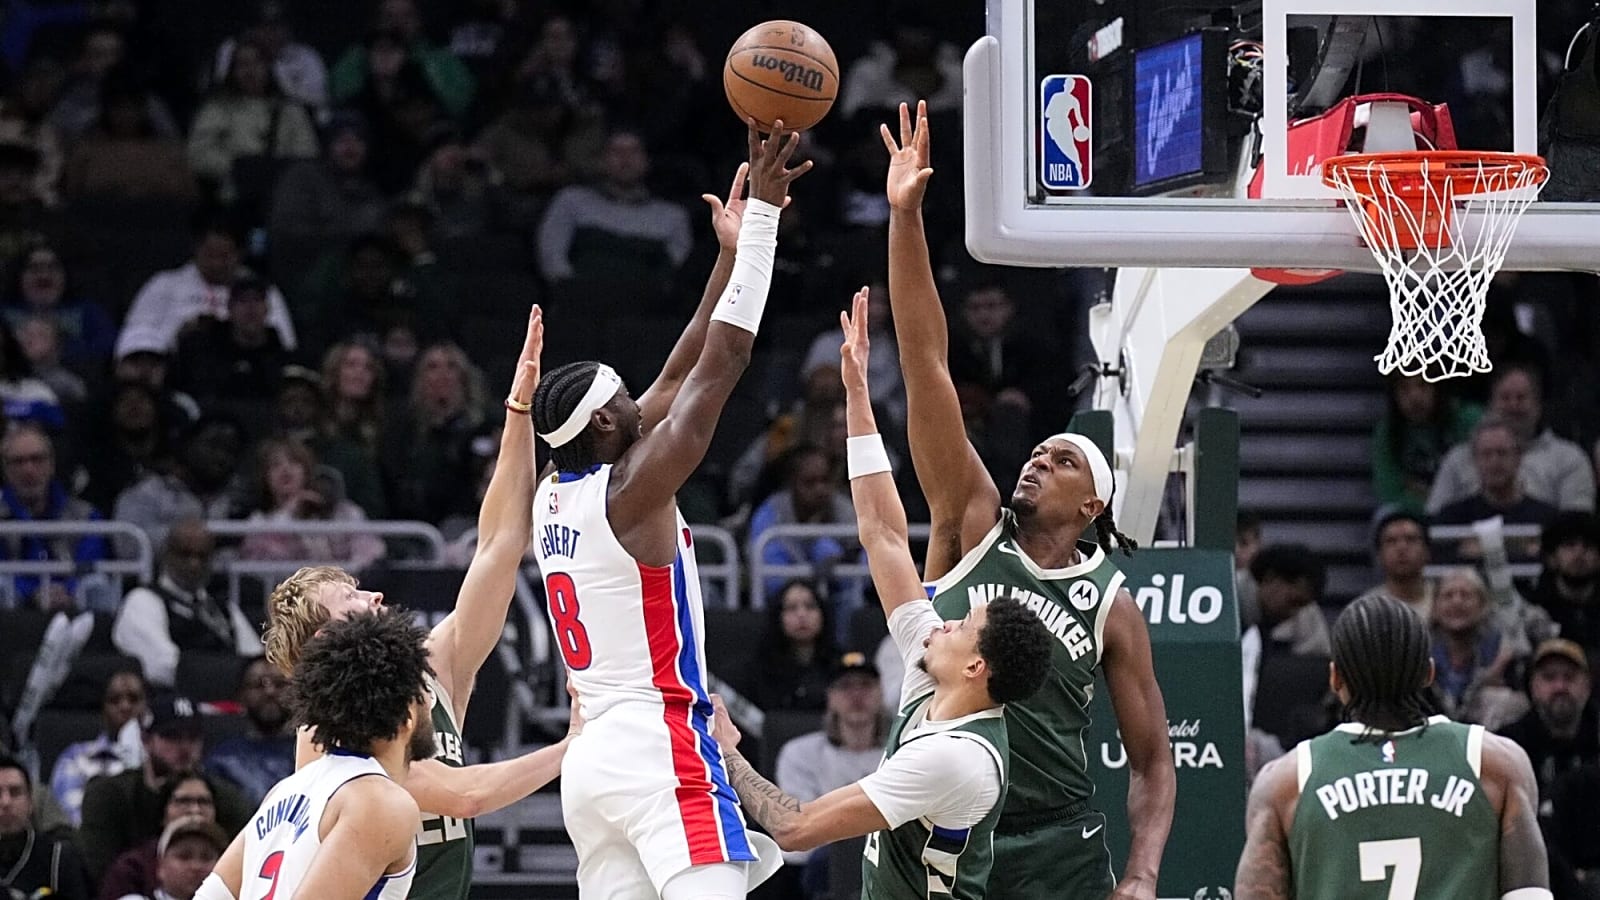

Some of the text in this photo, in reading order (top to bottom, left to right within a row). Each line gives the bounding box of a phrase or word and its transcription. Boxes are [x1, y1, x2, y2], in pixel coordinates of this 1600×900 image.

[752, 54, 824, 92] Wilson
[1049, 163, 1073, 182] NBA
[545, 571, 592, 671] 8
[1101, 742, 1224, 768] URA
[1316, 768, 1475, 821] PORTER JR
[1358, 837, 1422, 900] 7
